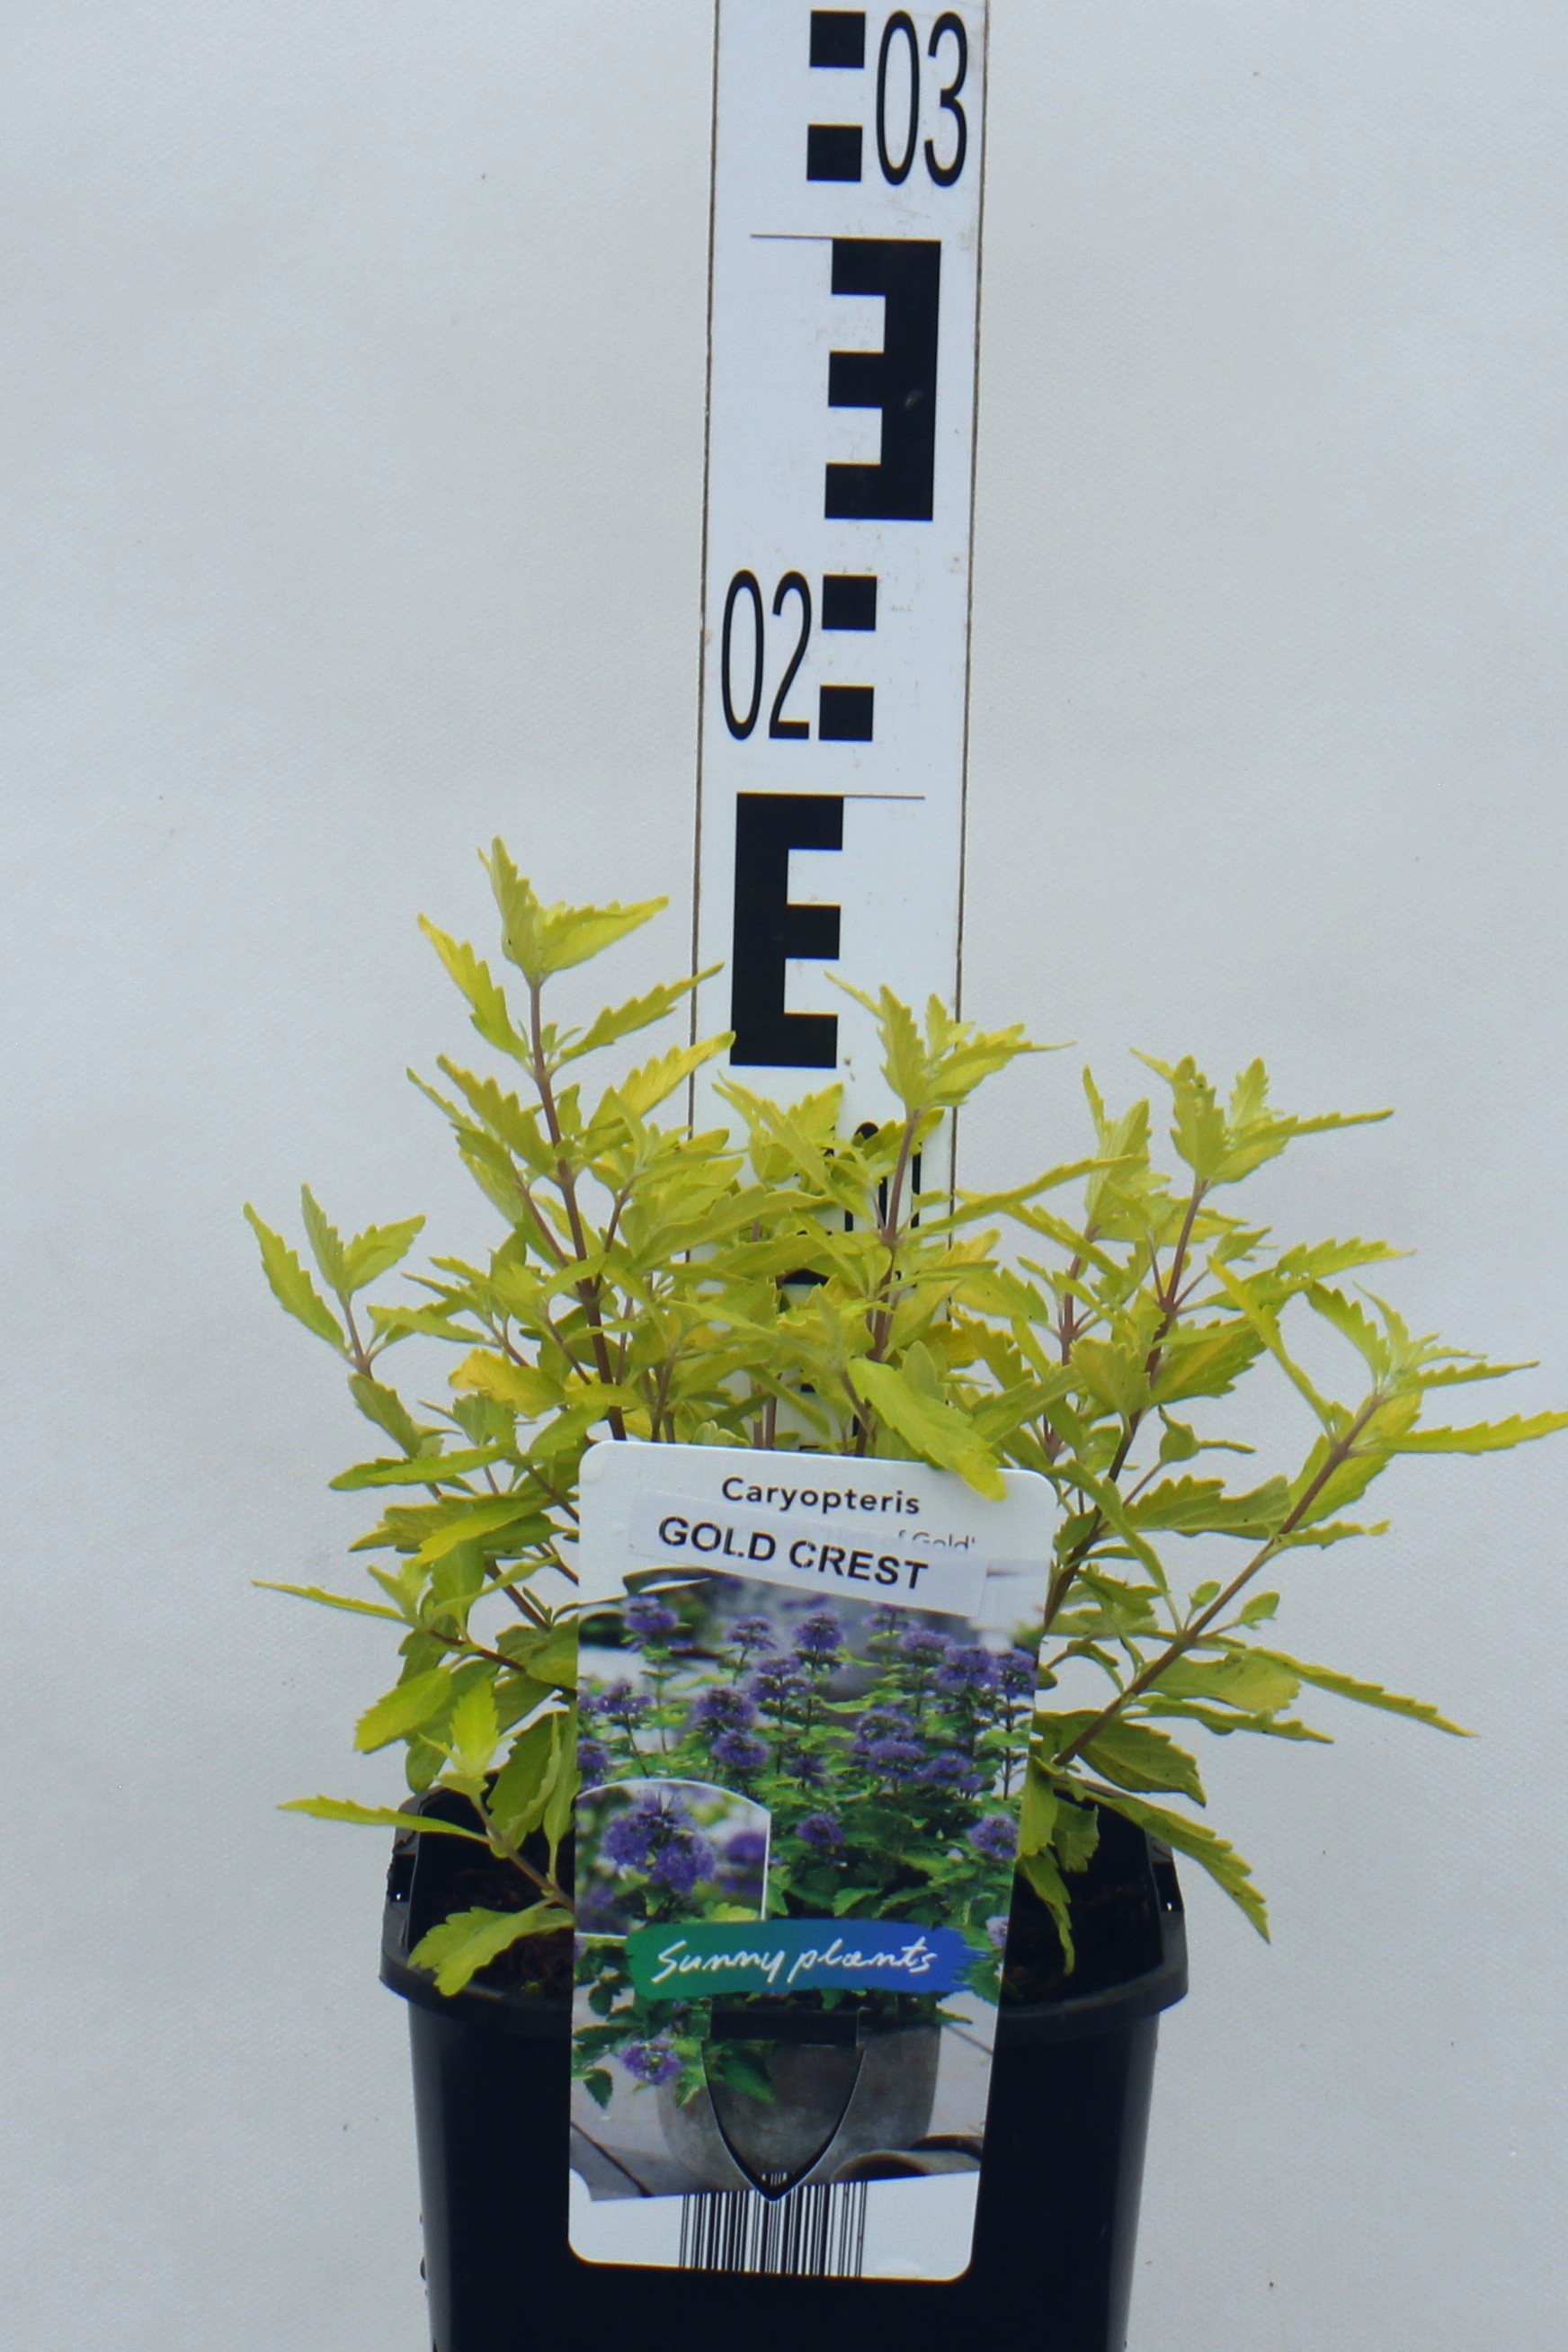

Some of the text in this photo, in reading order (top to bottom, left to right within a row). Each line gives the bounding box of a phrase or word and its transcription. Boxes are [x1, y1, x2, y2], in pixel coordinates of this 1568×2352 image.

[876, 11, 968, 187] 03
[721, 570, 811, 740] 02
[721, 1475, 920, 1515] Caryopteris
[658, 1515, 929, 1590] GOLD CREST
[651, 1936, 938, 1984] Sunny plants
